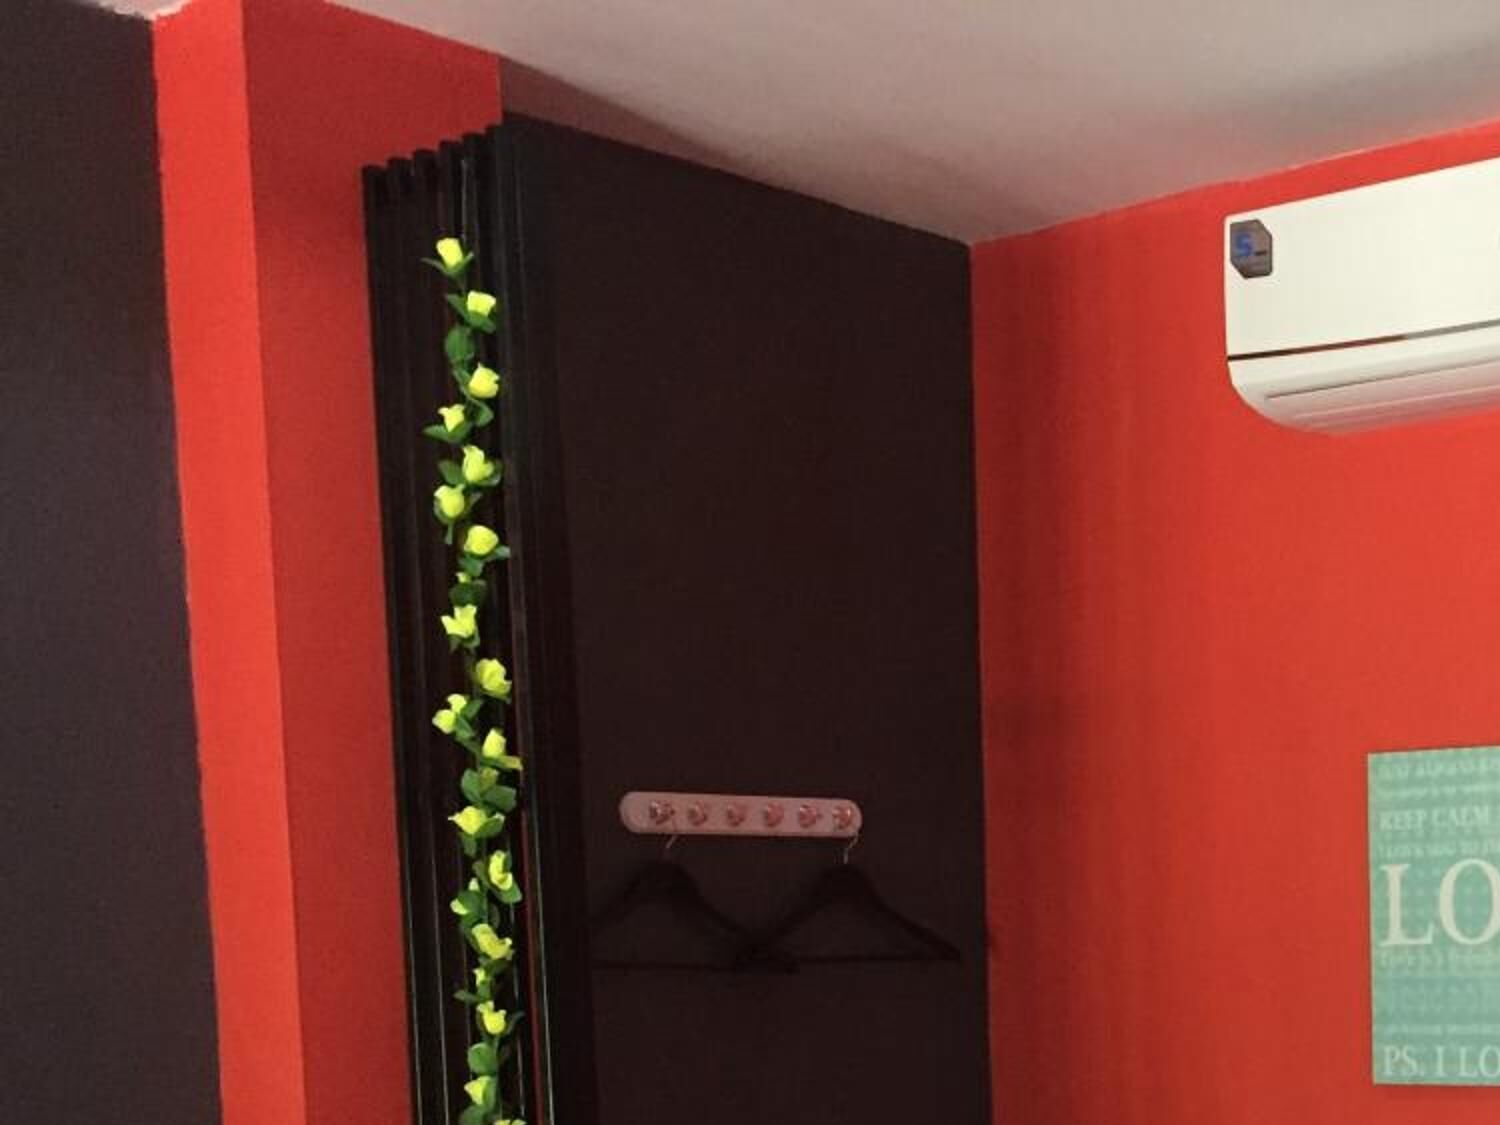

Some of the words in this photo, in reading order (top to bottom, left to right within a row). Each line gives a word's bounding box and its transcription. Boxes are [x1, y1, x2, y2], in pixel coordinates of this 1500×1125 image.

[1379, 808, 1427, 831] KEEP
[1431, 804, 1490, 828] CALM
[1382, 1045, 1425, 1077] PS.
[1434, 1046, 1448, 1077] I
